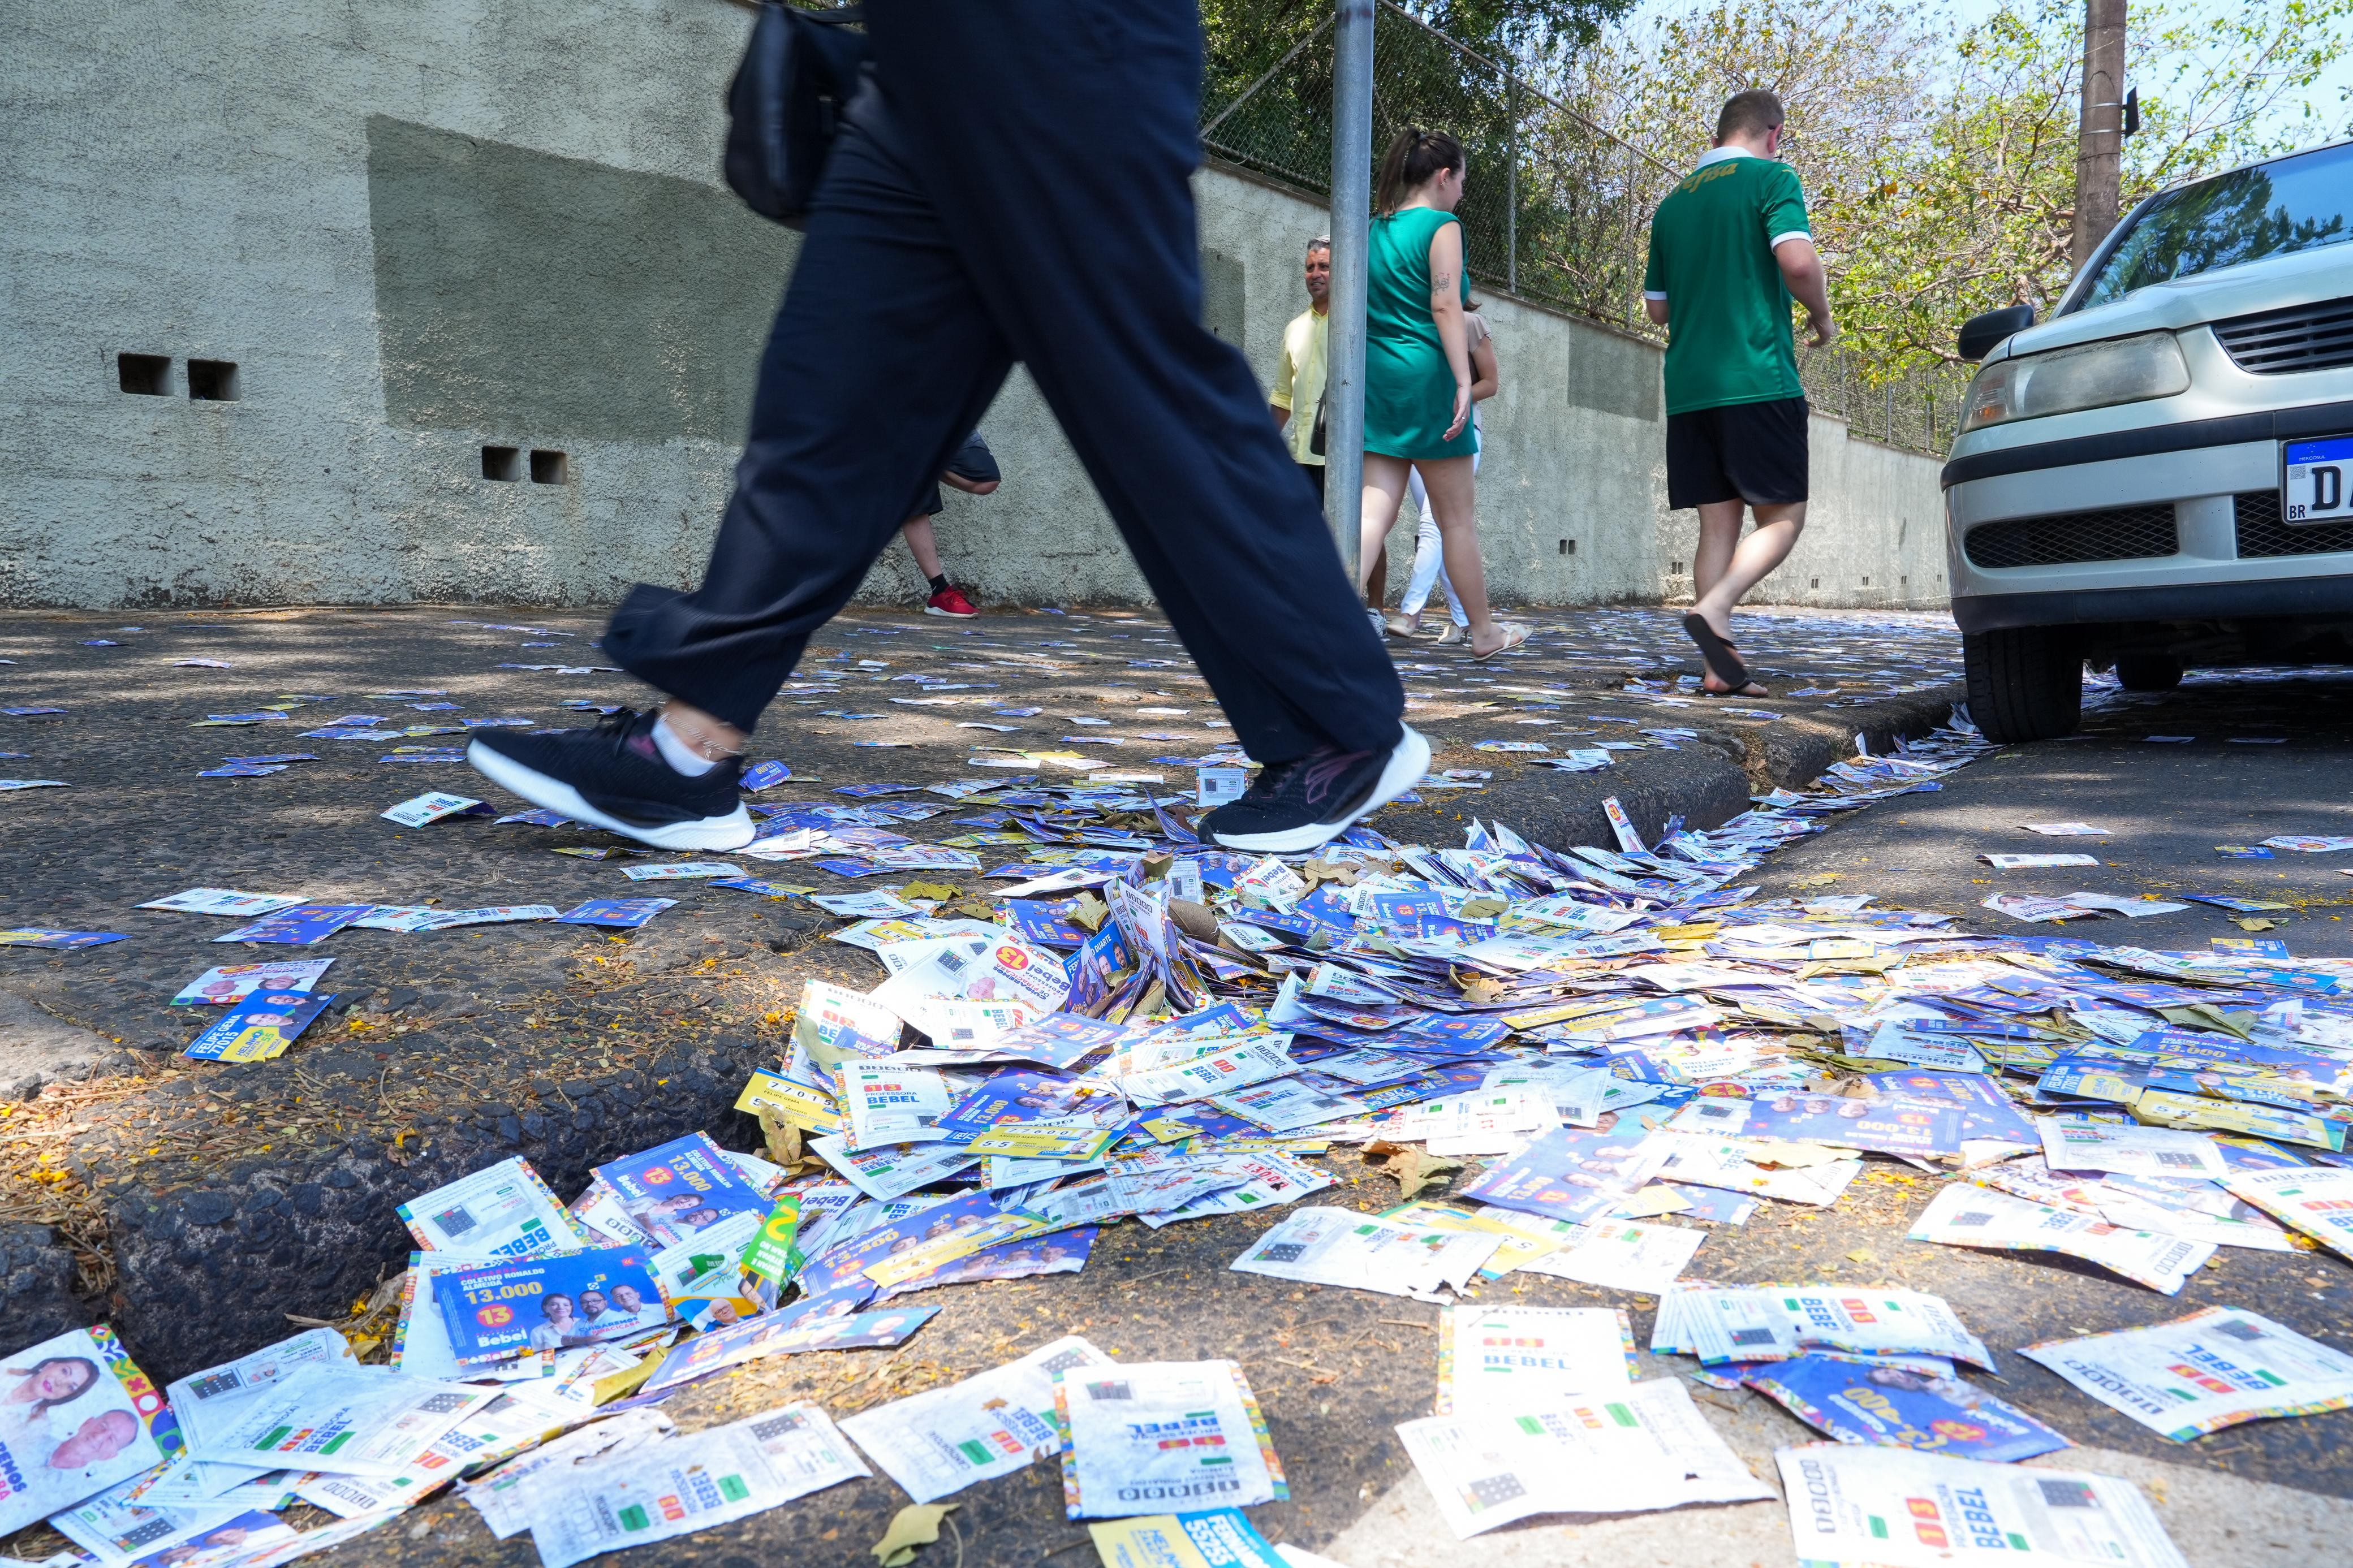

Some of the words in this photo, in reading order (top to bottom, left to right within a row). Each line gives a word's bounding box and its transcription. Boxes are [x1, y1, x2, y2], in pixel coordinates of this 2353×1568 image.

[1670, 163, 1739, 196] refisa
[2312, 465, 2353, 511] D
[2289, 505, 2305, 519] BR
[755, 761, 775, 774] 13.000
[1261, 865, 1285, 884] Bebel
[1382, 903, 1395, 919] Bebel
[1398, 906, 1413, 915] 13
[1568, 908, 1591, 919] BEBEL
[1094, 934, 1111, 953] DUARTE
[997, 947, 1027, 970] 13
[992, 966, 1046, 1000] CUIDAREMOS
[996, 963, 1041, 994] PIRACICABA
[1024, 971, 1065, 996] PROFESSORA
[1028, 964, 1070, 990] Bebel
[195, 1031, 223, 1054] FELIPE
[219, 1014, 243, 1033] GEMA
[207, 1031, 239, 1054] 77015
[262, 1033, 275, 1043] 55
[2158, 1043, 2226, 1058] 13.000
[1192, 1066, 1218, 1083] BEBEL
[1213, 1059, 1236, 1073] 13
[764, 1090, 783, 1099] FELIPE
[769, 1081, 833, 1106] 77015
[867, 1095, 919, 1104] BEBEL
[1249, 1090, 1298, 1107] BEBEL
[973, 1100, 1009, 1124] 13.000
[684, 1152, 705, 1172] ALMEIDA
[690, 1150, 713, 1172] COLETIVO
[709, 1167, 732, 1188] RONALDO
[645, 1168, 671, 1184] 13
[669, 1155, 712, 1191] 13.000
[617, 1174, 648, 1198] Bebel
[803, 1195, 851, 1207] Bebel
[620, 1217, 648, 1235] RONALDO
[824, 1231, 900, 1268] 13.400
[460, 1275, 503, 1286] COLETIVO
[505, 1268, 545, 1279] RONALDO
[835, 1259, 863, 1278] 13
[463, 1280, 503, 1291] ALMEIDA
[465, 1281, 543, 1304] 13.000
[478, 1307, 511, 1326] 13
[476, 1328, 527, 1347] Bebel
[1484, 1355, 1572, 1369] BEBEL
[2181, 1344, 2271, 1390] BEBEL
[243, 1406, 300, 1449] CANDIDATO(A)
[1011, 1407, 1053, 1441] BEBEL
[304, 1419, 353, 1453] BEBEL
[690, 1471, 722, 1509] BEBEL
[1908, 1498, 1947, 1547] 13
[1955, 1486, 2006, 1549] BEBEL
[1185, 1519, 1235, 1566] 55255
